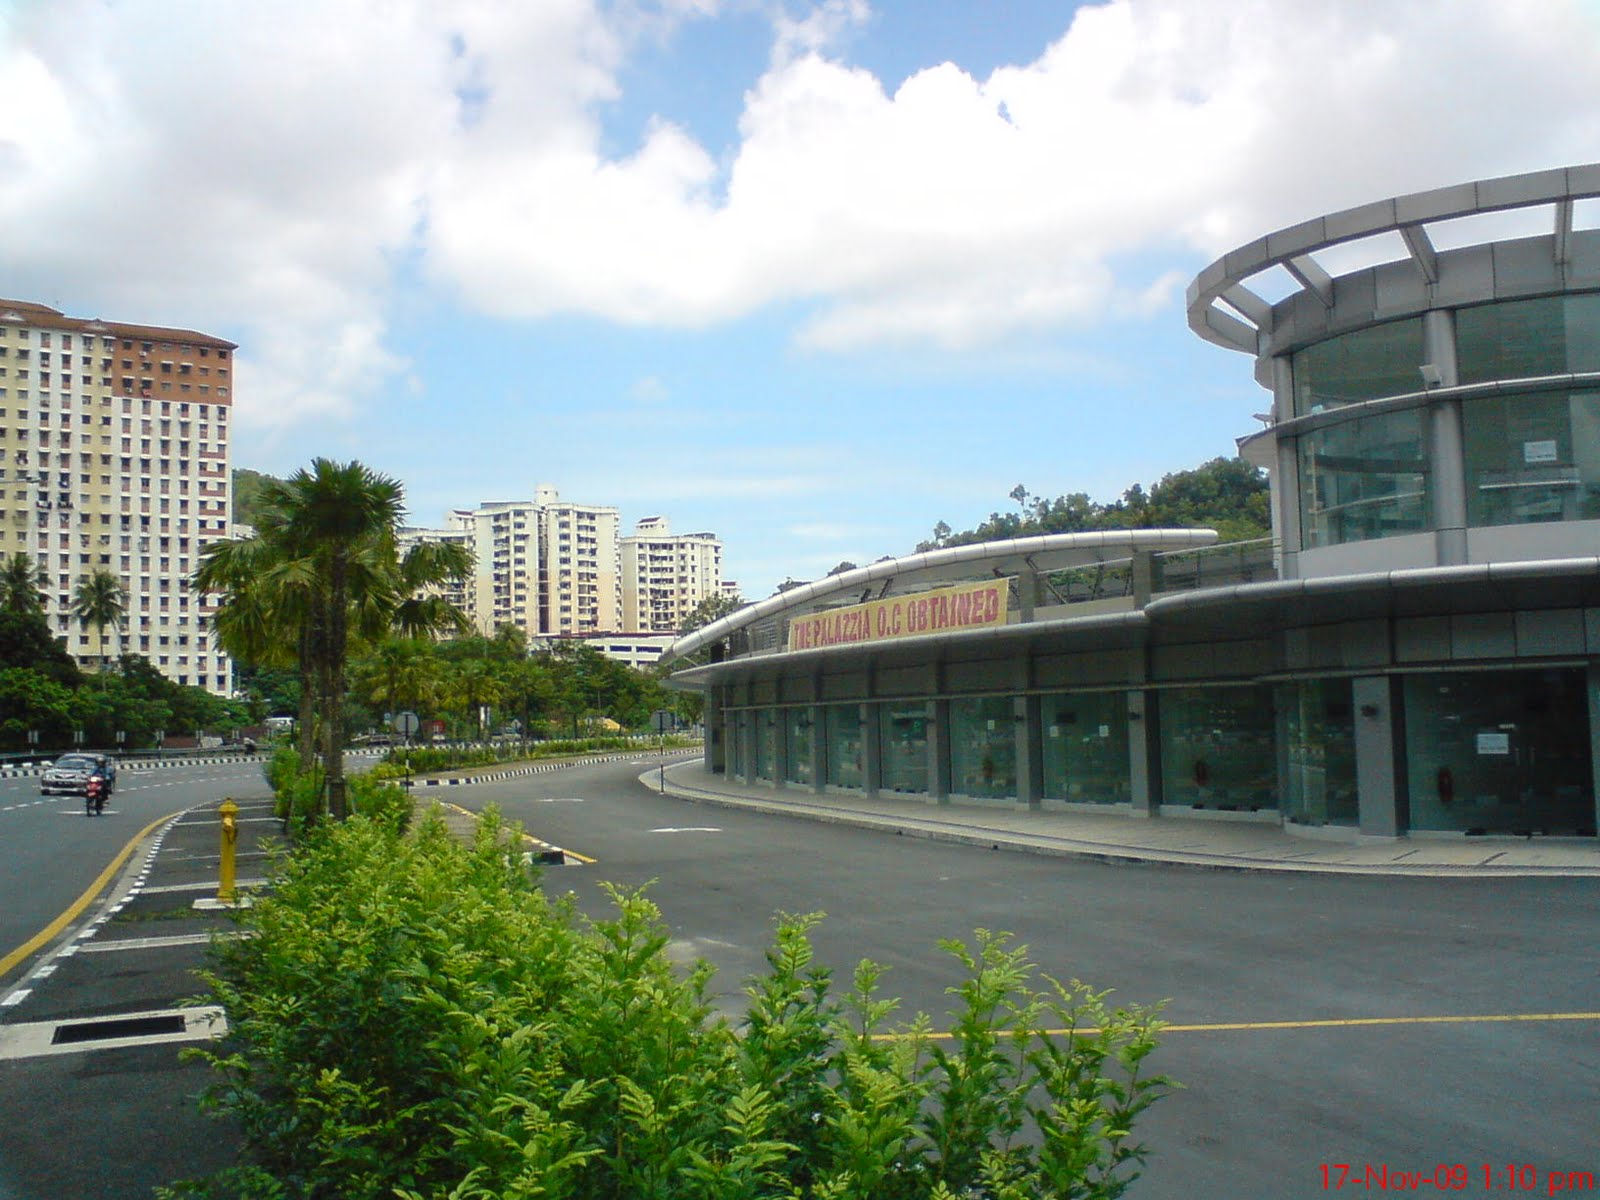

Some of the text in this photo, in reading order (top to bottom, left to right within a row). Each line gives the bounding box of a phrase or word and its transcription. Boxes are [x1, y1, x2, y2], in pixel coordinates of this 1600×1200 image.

[794, 621, 812, 650] THE
[813, 609, 871, 647] PALAZZIA
[907, 588, 999, 633] OBTAINED
